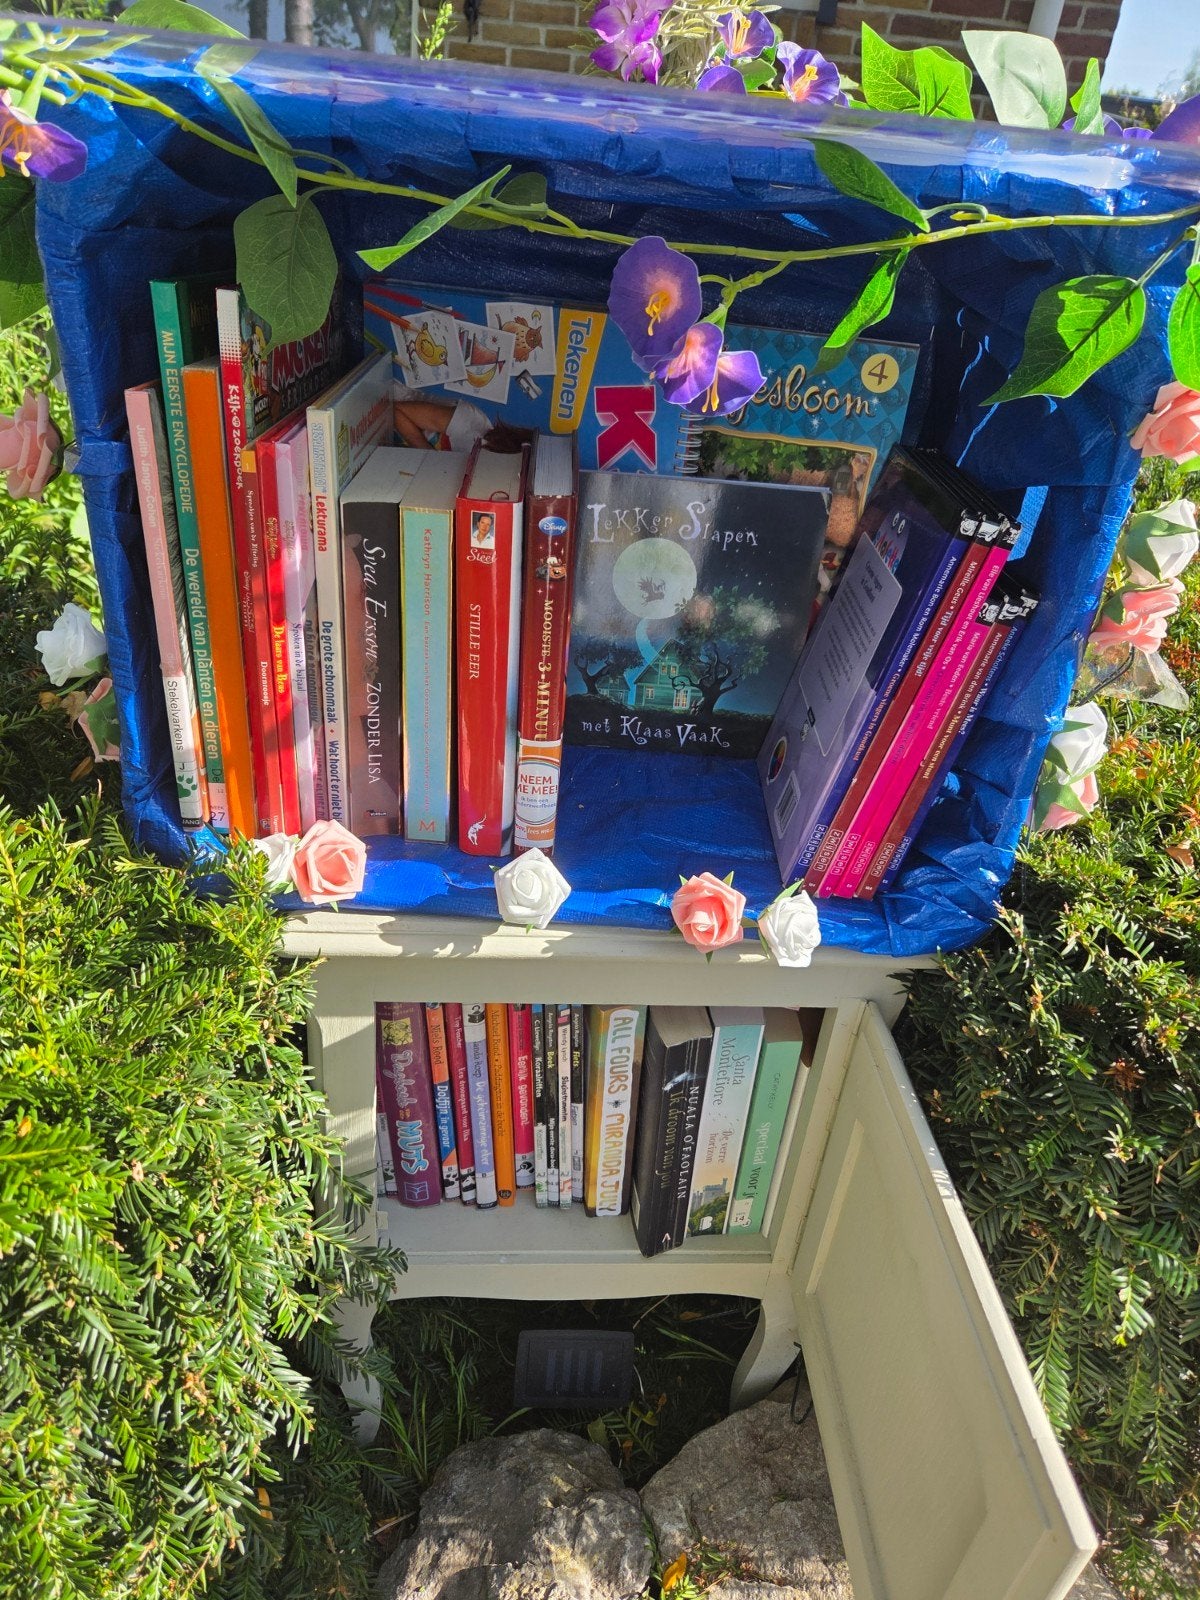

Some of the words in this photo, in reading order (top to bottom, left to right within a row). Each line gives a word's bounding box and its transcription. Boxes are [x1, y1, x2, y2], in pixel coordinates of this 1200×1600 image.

[161, 330, 176, 364] MIJN
[556, 316, 592, 420] Tekenen
[867, 358, 889, 386] 4
[166, 368, 183, 417] EERSTE
[727, 363, 873, 425] esboom
[593, 384, 657, 471] K
[136, 425, 148, 457] Judith
[142, 460, 157, 528] Jango-Cohen
[171, 420, 193, 515] ENCYCLOPEDIE
[315, 495, 328, 552] Lekturama
[542, 521, 567, 534] Disney
[678, 501, 759, 551] Slapen
[184, 548, 200, 567] De
[421, 528, 433, 569] Kathryn
[466, 548, 498, 565] Steel
[362, 537, 387, 591] Svea
[934, 556, 957, 593] Annemarie
[959, 561, 978, 587] Mireille
[186, 570, 207, 618] wereld
[423, 574, 433, 615] Harrison
[950, 587, 964, 605] Geus
[983, 578, 992, 592] van
[923, 608, 932, 619] en
[930, 593, 940, 608] Bon
[968, 591, 986, 622] Lieshout
[193, 622, 206, 645] van
[273, 625, 285, 639] De
[321, 621, 334, 634] De
[364, 596, 387, 663] Ersson
[469, 603, 481, 650] STILLE
[541, 599, 554, 657] MOOISTE
[916, 617, 928, 632] Rom
[940, 611, 954, 630] Tijd
[962, 621, 971, 632] en
[292, 623, 303, 650] Spoken
[321, 635, 335, 662] grote
[931, 626, 946, 646] voor
[948, 642, 959, 656] van
[955, 629, 967, 644] Erik
[969, 632, 981, 648] Maria
[981, 632, 1003, 665] Annemarie
[294, 650, 302, 659] in
[295, 659, 304, 668] de
[898, 632, 920, 671] Molemaker
[922, 643, 936, 662] vrije
[942, 656, 952, 667] Os
[960, 648, 971, 663] van
[193, 648, 212, 698] planten
[275, 660, 284, 673] van
[469, 653, 481, 680] EER
[914, 659, 928, 677] tijd!
[950, 662, 965, 683] Eeden
[974, 665, 984, 680] van
[987, 650, 1007, 682] Scholtens
[260, 661, 271, 706] Doornroosje
[324, 663, 339, 724] schoonmaak
[884, 672, 901, 697] Groene
[969, 680, 979, 692] den
[202, 702, 214, 718] en
[961, 691, 972, 710] Brink
[167, 680, 184, 751] Stekelvarkens
[366, 682, 382, 748] ZONDER
[204, 723, 219, 759] dieren
[581, 718, 611, 734] met
[620, 715, 672, 745] Klaas
[329, 740, 339, 760] Wat
[330, 760, 342, 782] hoort
[367, 753, 383, 784] LISA
[520, 773, 552, 785] NEEM
[330, 782, 340, 793] er
[517, 784, 529, 794] ME
[531, 785, 558, 795] MEE!
[331, 794, 342, 810] niet
[419, 820, 435, 833] M
[799, 824, 828, 866] zwijsen
[814, 829, 844, 871] zwijsen
[831, 833, 861, 875] zwijsen
[430, 1024, 441, 1044] Niels
[491, 1009, 501, 1037] Michael
[611, 1015, 634, 1044] ALL
[547, 1051, 555, 1069] Boek
[572, 1051, 581, 1068] Fiets
[607, 1045, 631, 1095] FOURS
[712, 1037, 737, 1106] Montefiore
[731, 1053, 751, 1086] Santa
[382, 1049, 418, 1108] Dagboek
[534, 1057, 544, 1098] Koraalriffen
[435, 1085, 451, 1114] Dolfijn
[669, 1089, 685, 1107] Ik
[683, 1085, 700, 1131] NUALA
[440, 1116, 449, 1124] in
[666, 1106, 686, 1147] droom
[395, 1119, 430, 1175] MUTS
[438, 1124, 451, 1148] gevaar
[602, 1112, 626, 1179] MIRANDA
[704, 1132, 718, 1164] horizon
[752, 1121, 771, 1166] speciaal
[662, 1147, 676, 1169] van
[717, 1141, 729, 1164] verre
[655, 1168, 675, 1189] jou
[747, 1166, 762, 1193] voor
[598, 1179, 621, 1212] JULY
